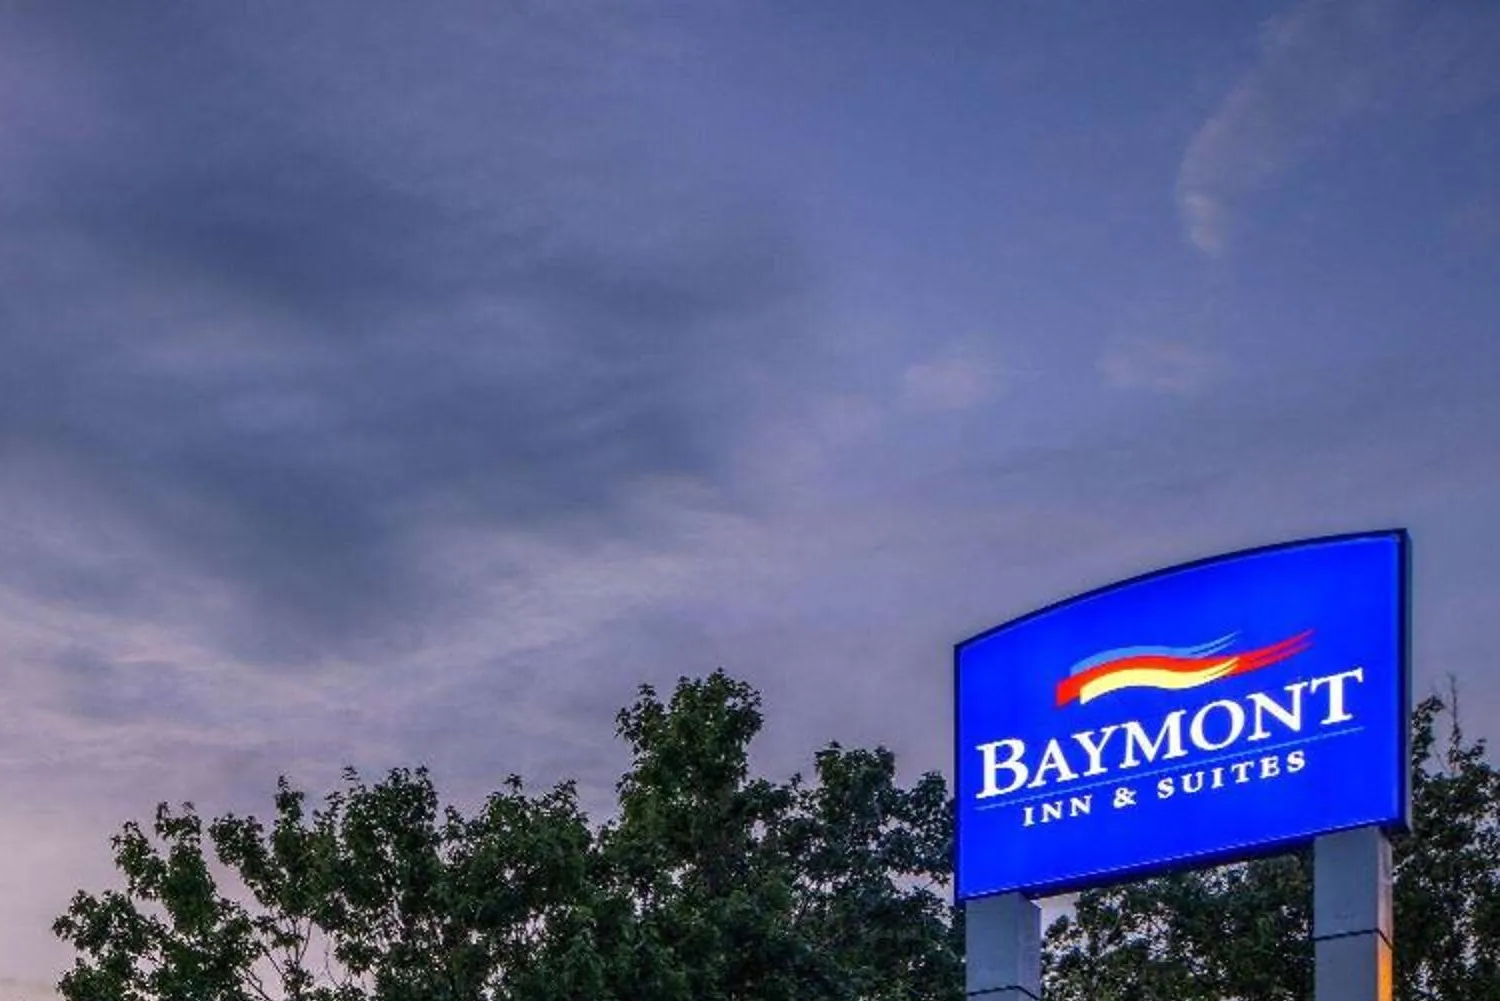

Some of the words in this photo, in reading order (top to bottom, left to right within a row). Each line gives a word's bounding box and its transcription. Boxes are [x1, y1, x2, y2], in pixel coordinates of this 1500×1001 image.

[975, 667, 1365, 800] BAYMONT
[1022, 794, 1094, 828] INN
[1112, 786, 1138, 810] &
[1156, 750, 1307, 800] SUITES
